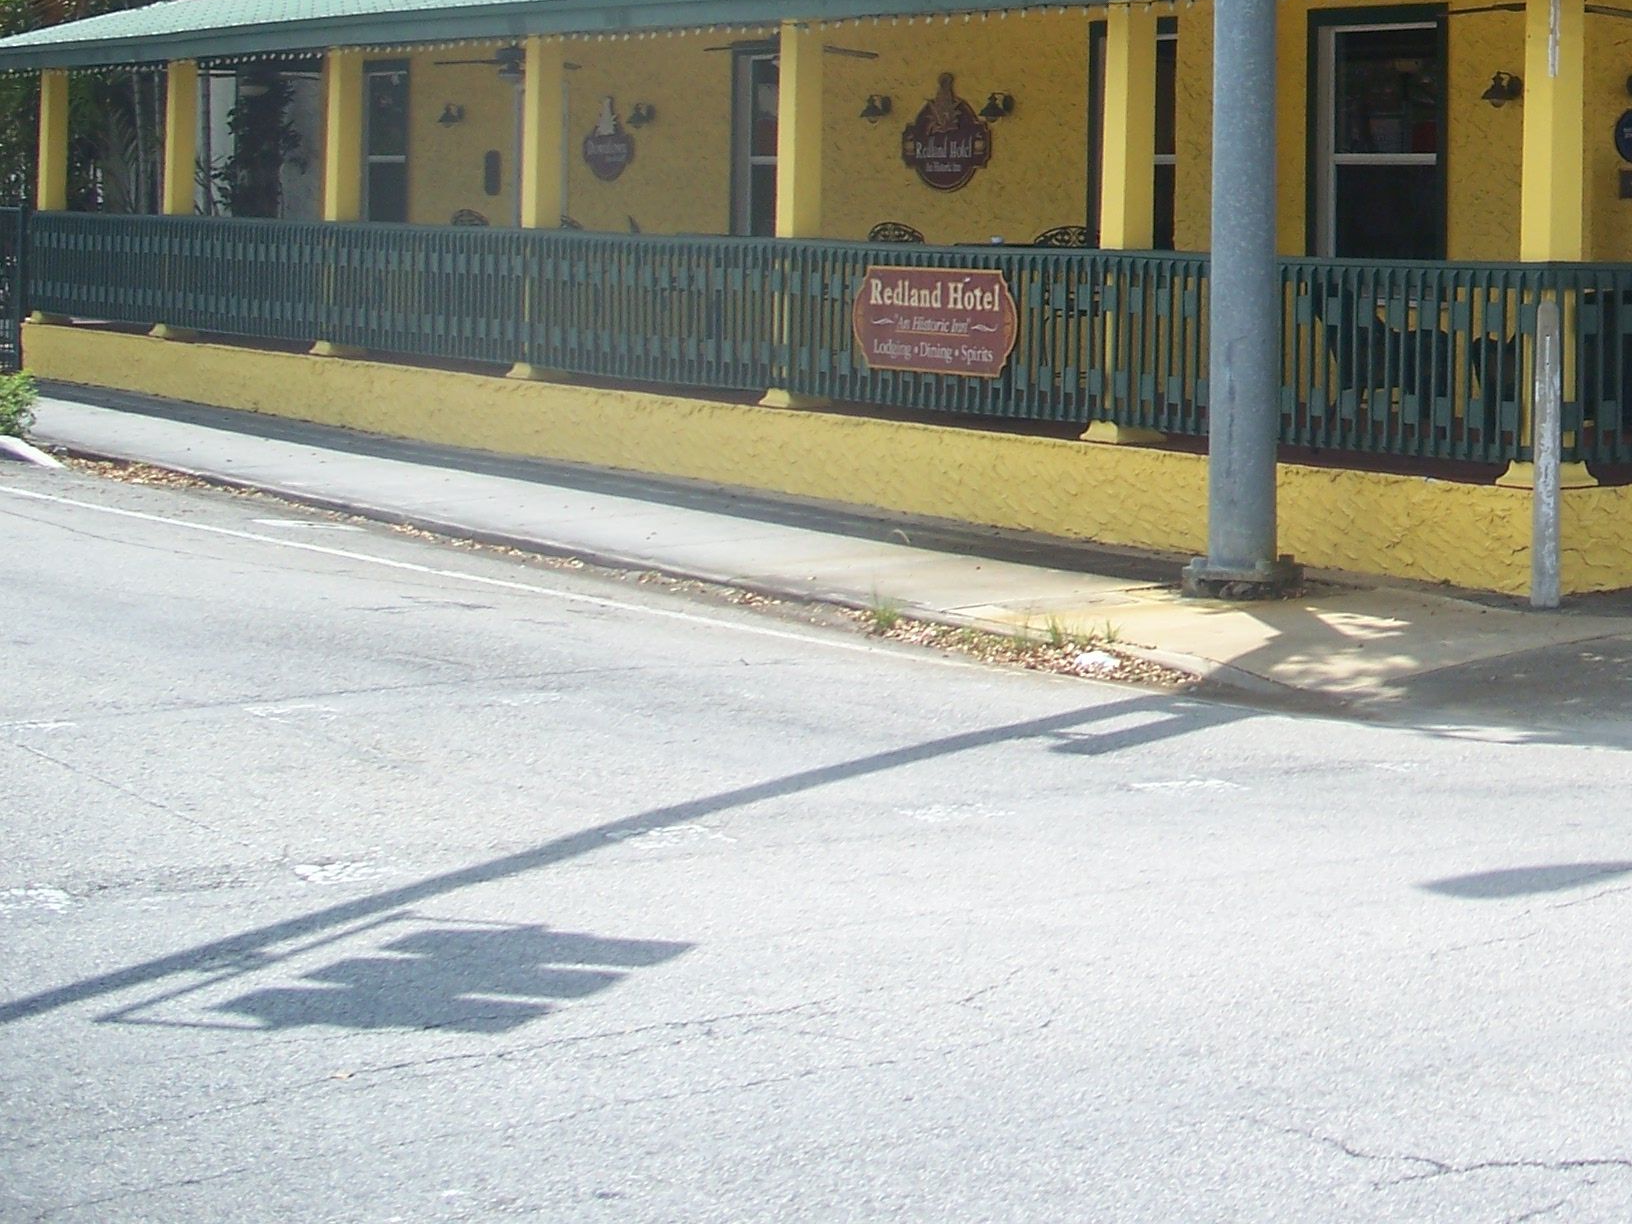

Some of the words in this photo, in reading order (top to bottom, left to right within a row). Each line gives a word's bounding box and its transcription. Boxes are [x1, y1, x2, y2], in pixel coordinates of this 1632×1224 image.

[870, 278, 942, 308] Redland
[948, 282, 1000, 311] Hotel
[912, 316, 950, 332] Historic
[873, 339, 912, 360] Lodging
[919, 342, 953, 363] Dining
[961, 345, 993, 365] Spirits
